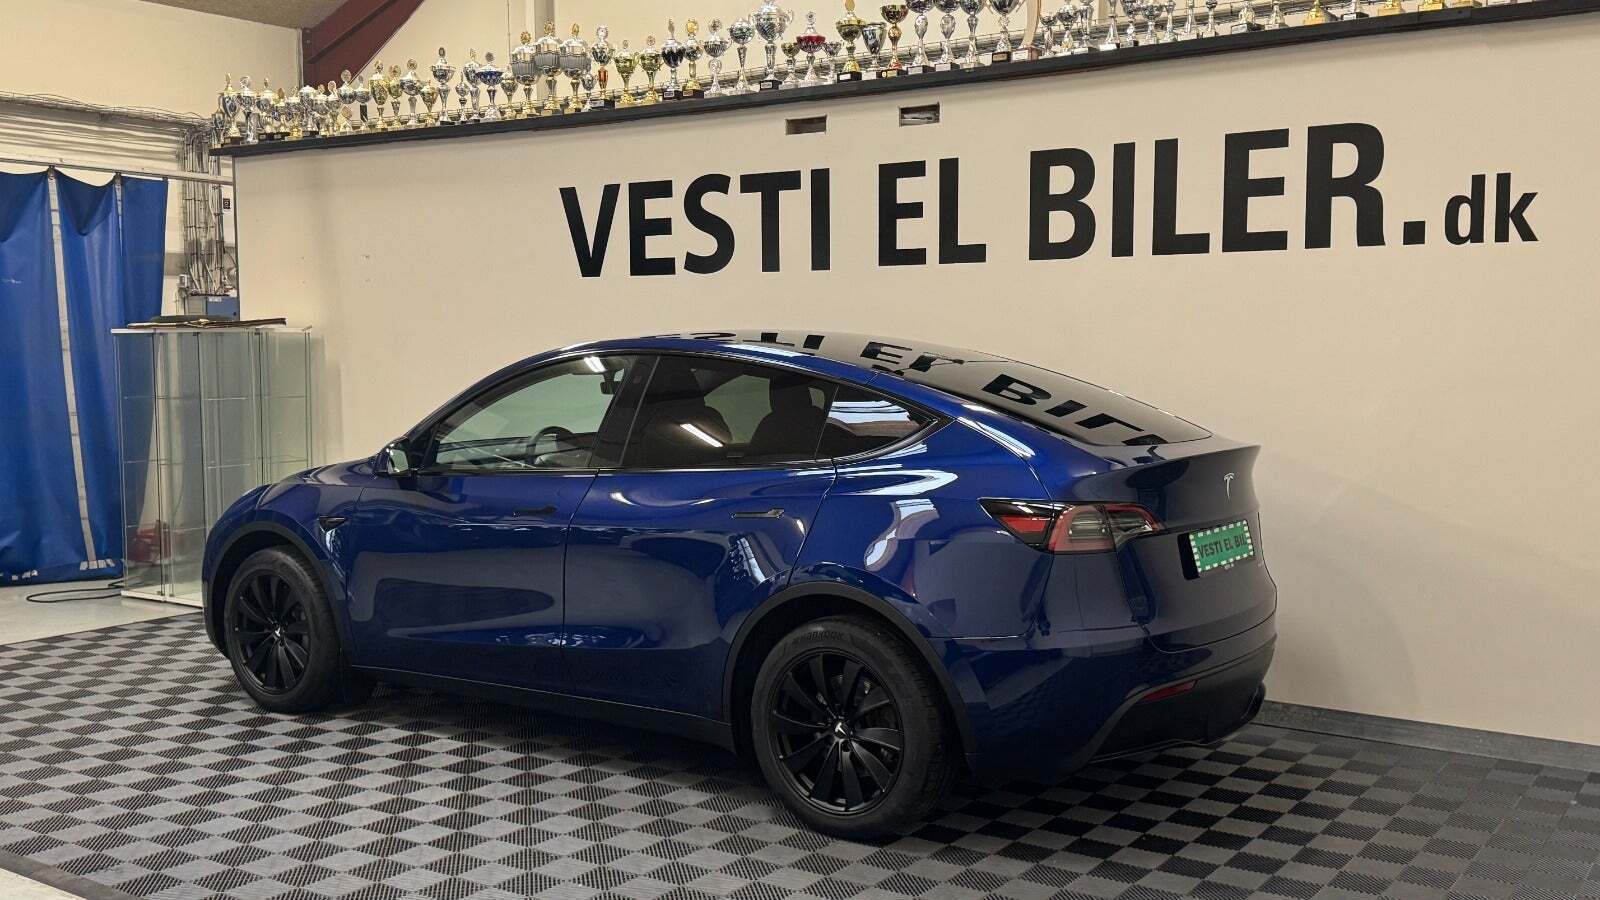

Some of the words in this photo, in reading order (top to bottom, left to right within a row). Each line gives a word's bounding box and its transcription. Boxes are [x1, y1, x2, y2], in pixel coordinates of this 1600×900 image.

[559, 167, 831, 278] VESTI
[879, 157, 987, 267] EL
[1197, 541, 1223, 559] VESTI
[1223, 538, 1234, 552] EL
